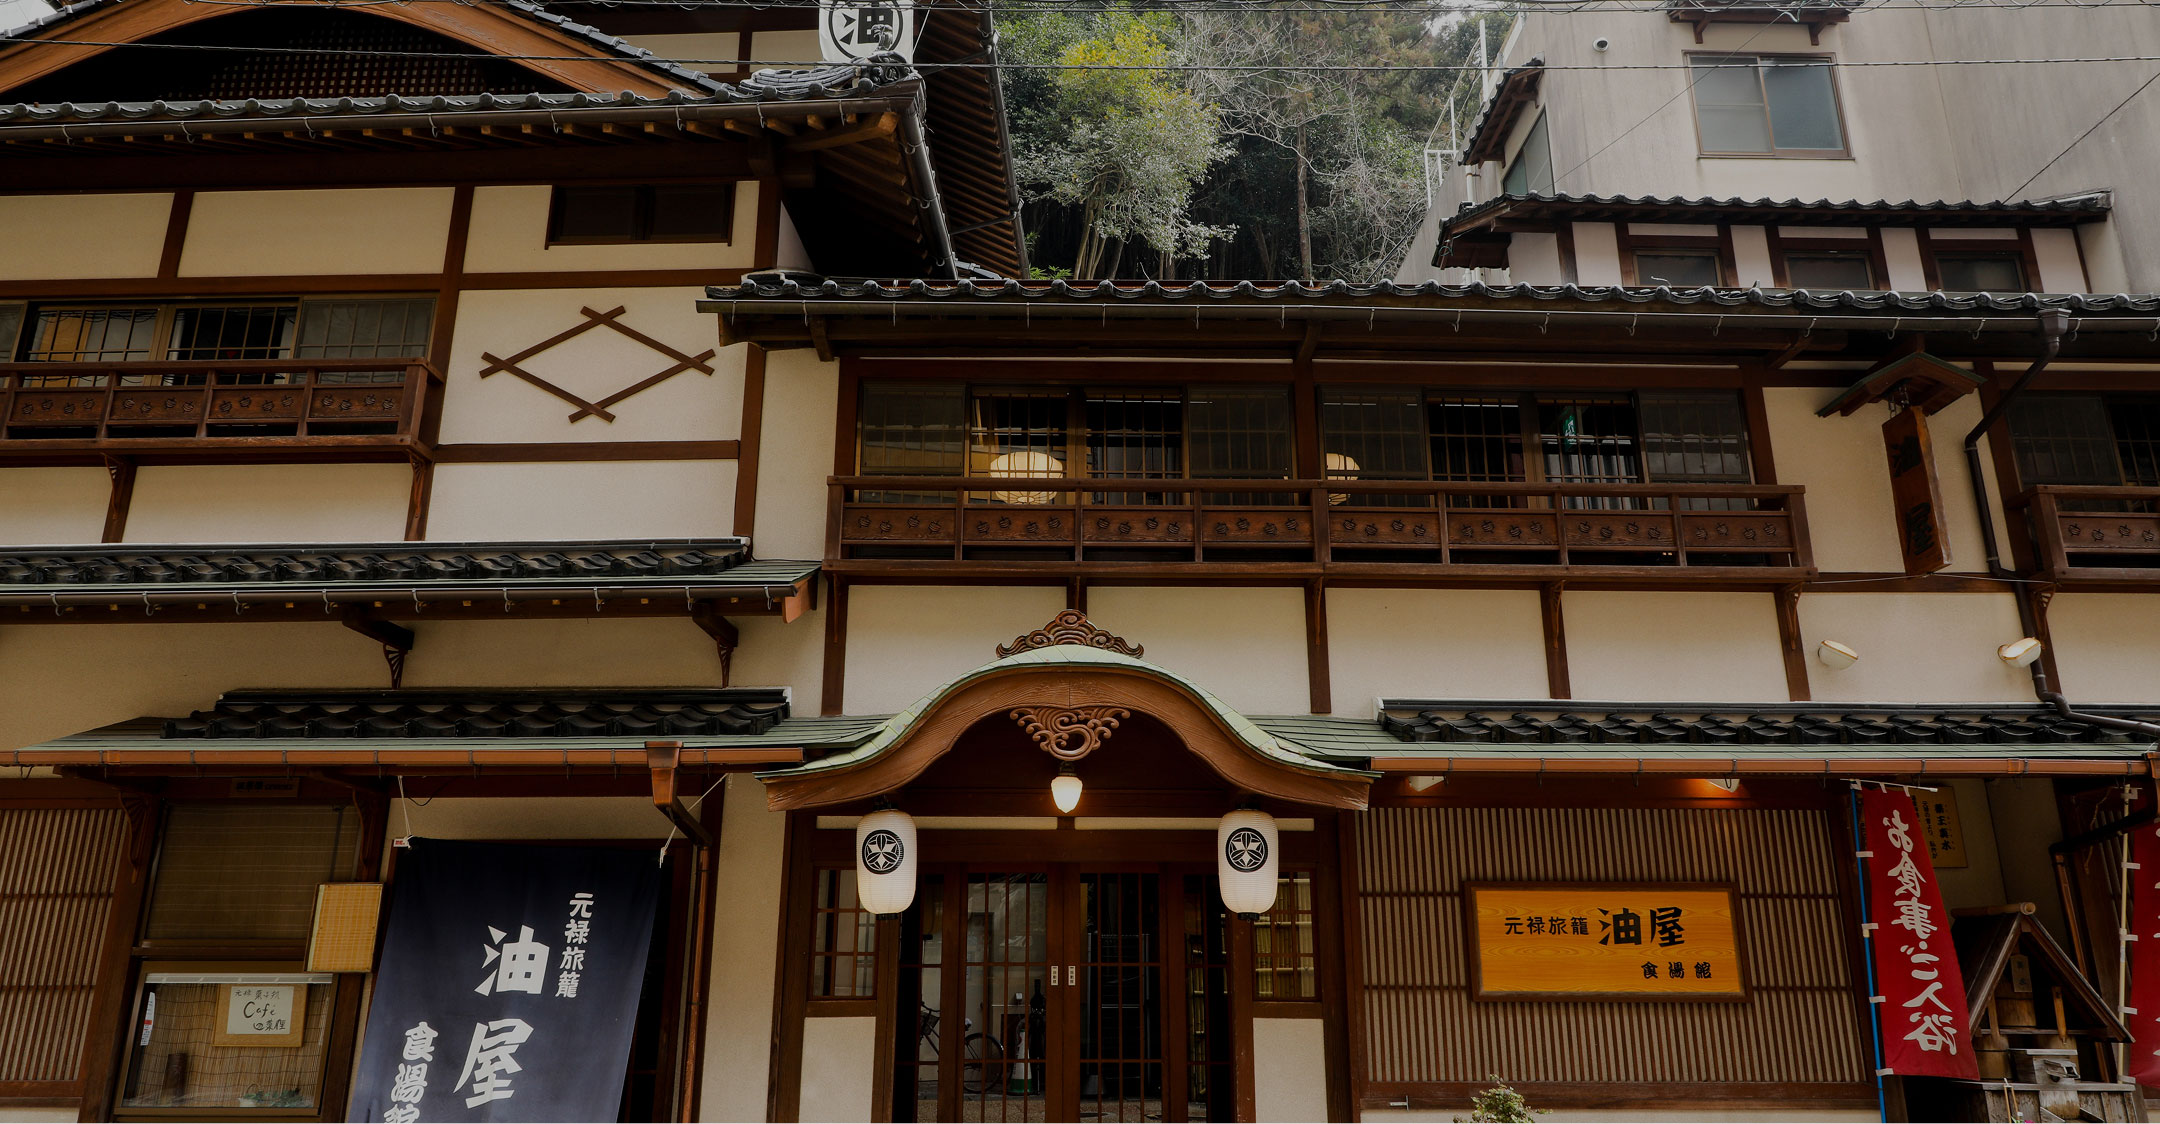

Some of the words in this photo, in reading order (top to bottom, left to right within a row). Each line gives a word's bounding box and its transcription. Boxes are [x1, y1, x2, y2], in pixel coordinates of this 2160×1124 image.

[1891, 435, 1935, 556] 油屋
[555, 892, 594, 998] 元禄旅籠
[1504, 916, 1589, 935] 元禄旅籠
[1598, 906, 1685, 947] 油屋
[453, 924, 551, 1109] 油屋
